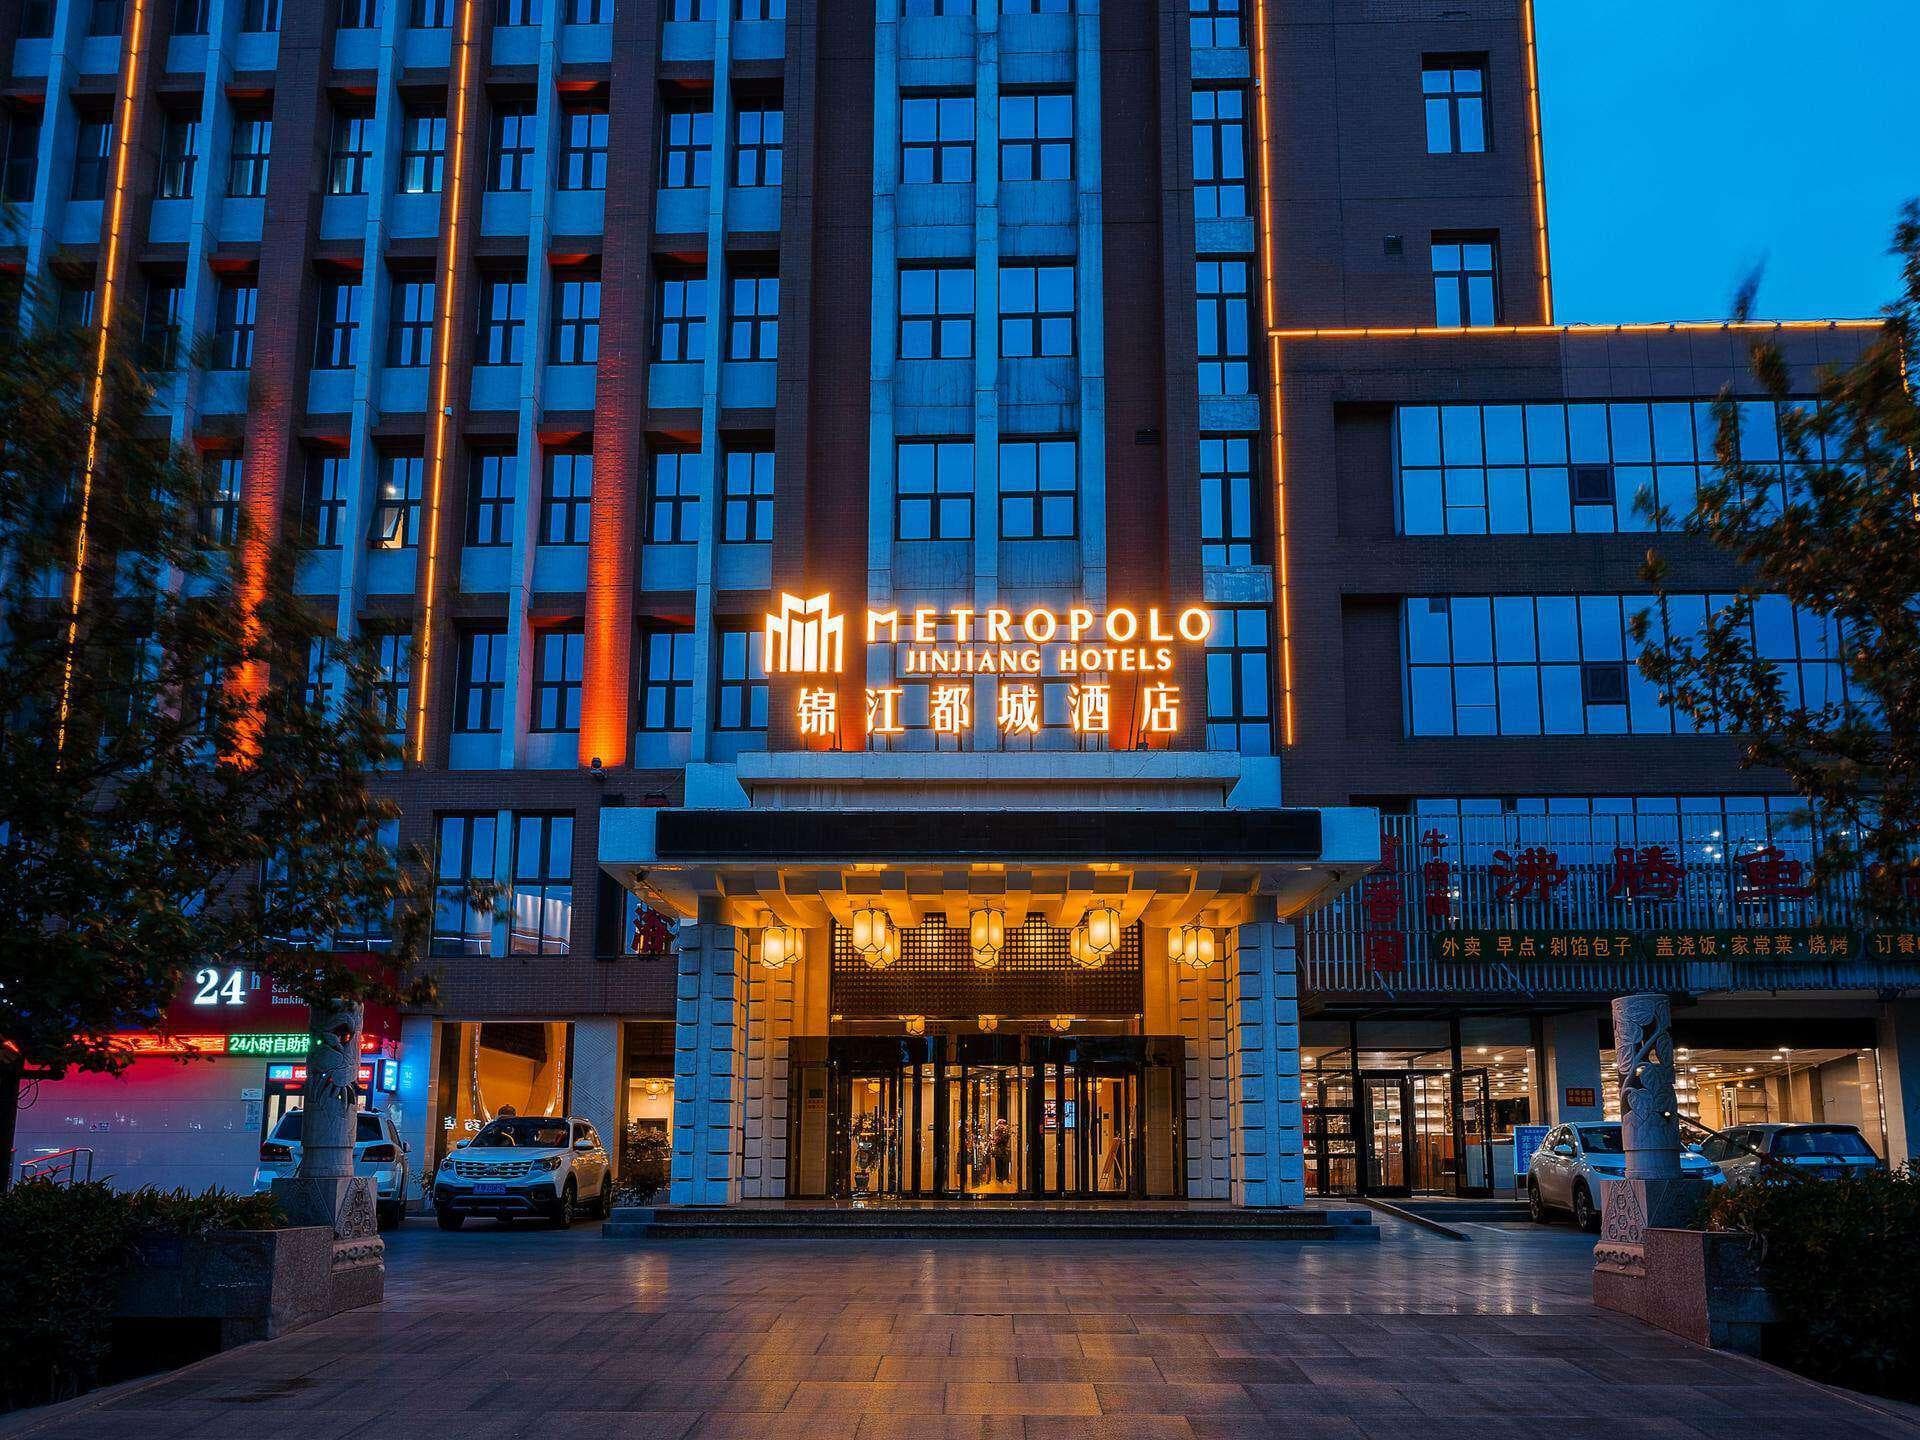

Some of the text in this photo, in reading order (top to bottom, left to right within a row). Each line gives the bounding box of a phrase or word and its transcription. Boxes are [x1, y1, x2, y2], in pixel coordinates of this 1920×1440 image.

[866, 607, 1212, 643] METROPOLO
[905, 647, 1173, 673] JINJIANG HOTELS
[796, 683, 1181, 736] 锦江都城酒店
[1441, 936, 1481, 959] 外卖
[1874, 933, 1920, 956] 订餐
[193, 968, 246, 1005] 24
